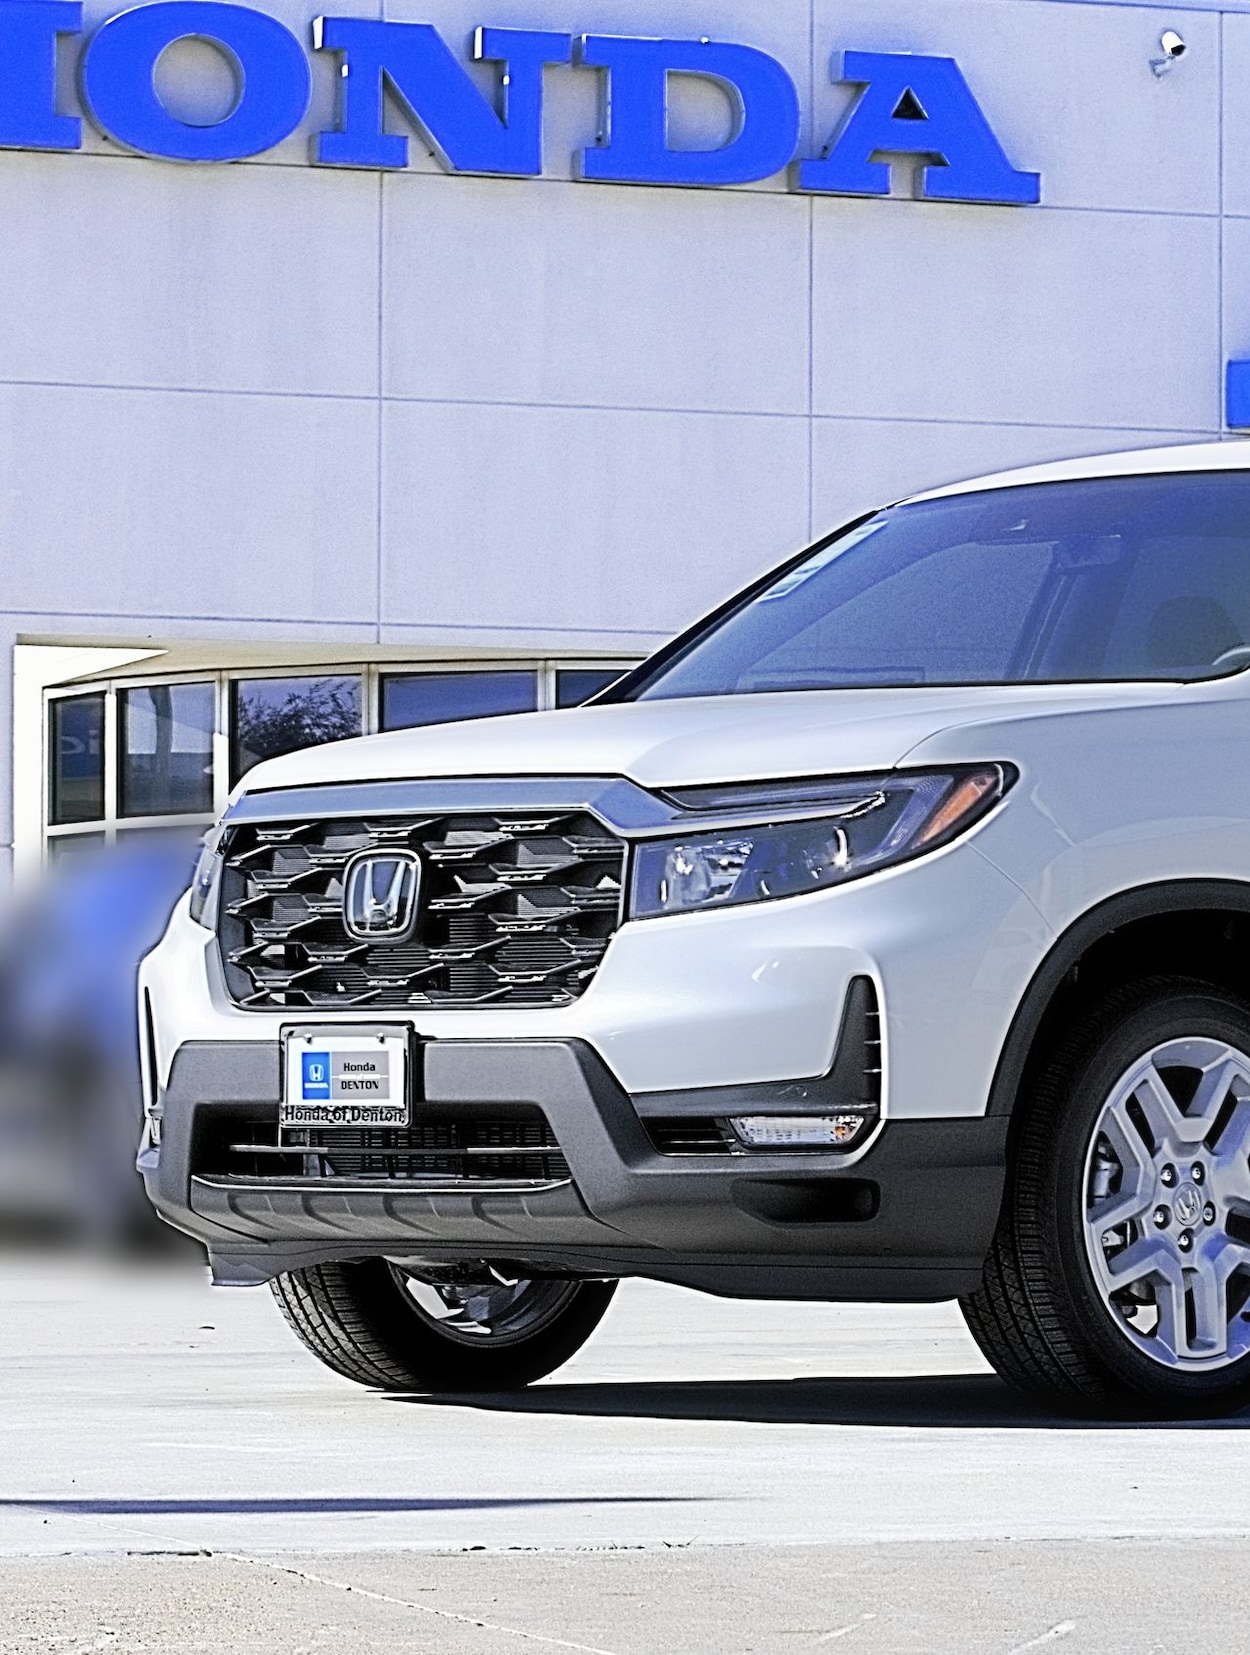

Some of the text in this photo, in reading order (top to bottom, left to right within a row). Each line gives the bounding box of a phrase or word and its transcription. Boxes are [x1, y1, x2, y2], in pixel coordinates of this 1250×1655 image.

[343, 1062, 376, 1072] Honda
[341, 1080, 379, 1090] DENTON
[285, 1105, 403, 1122] Honda of Denton
